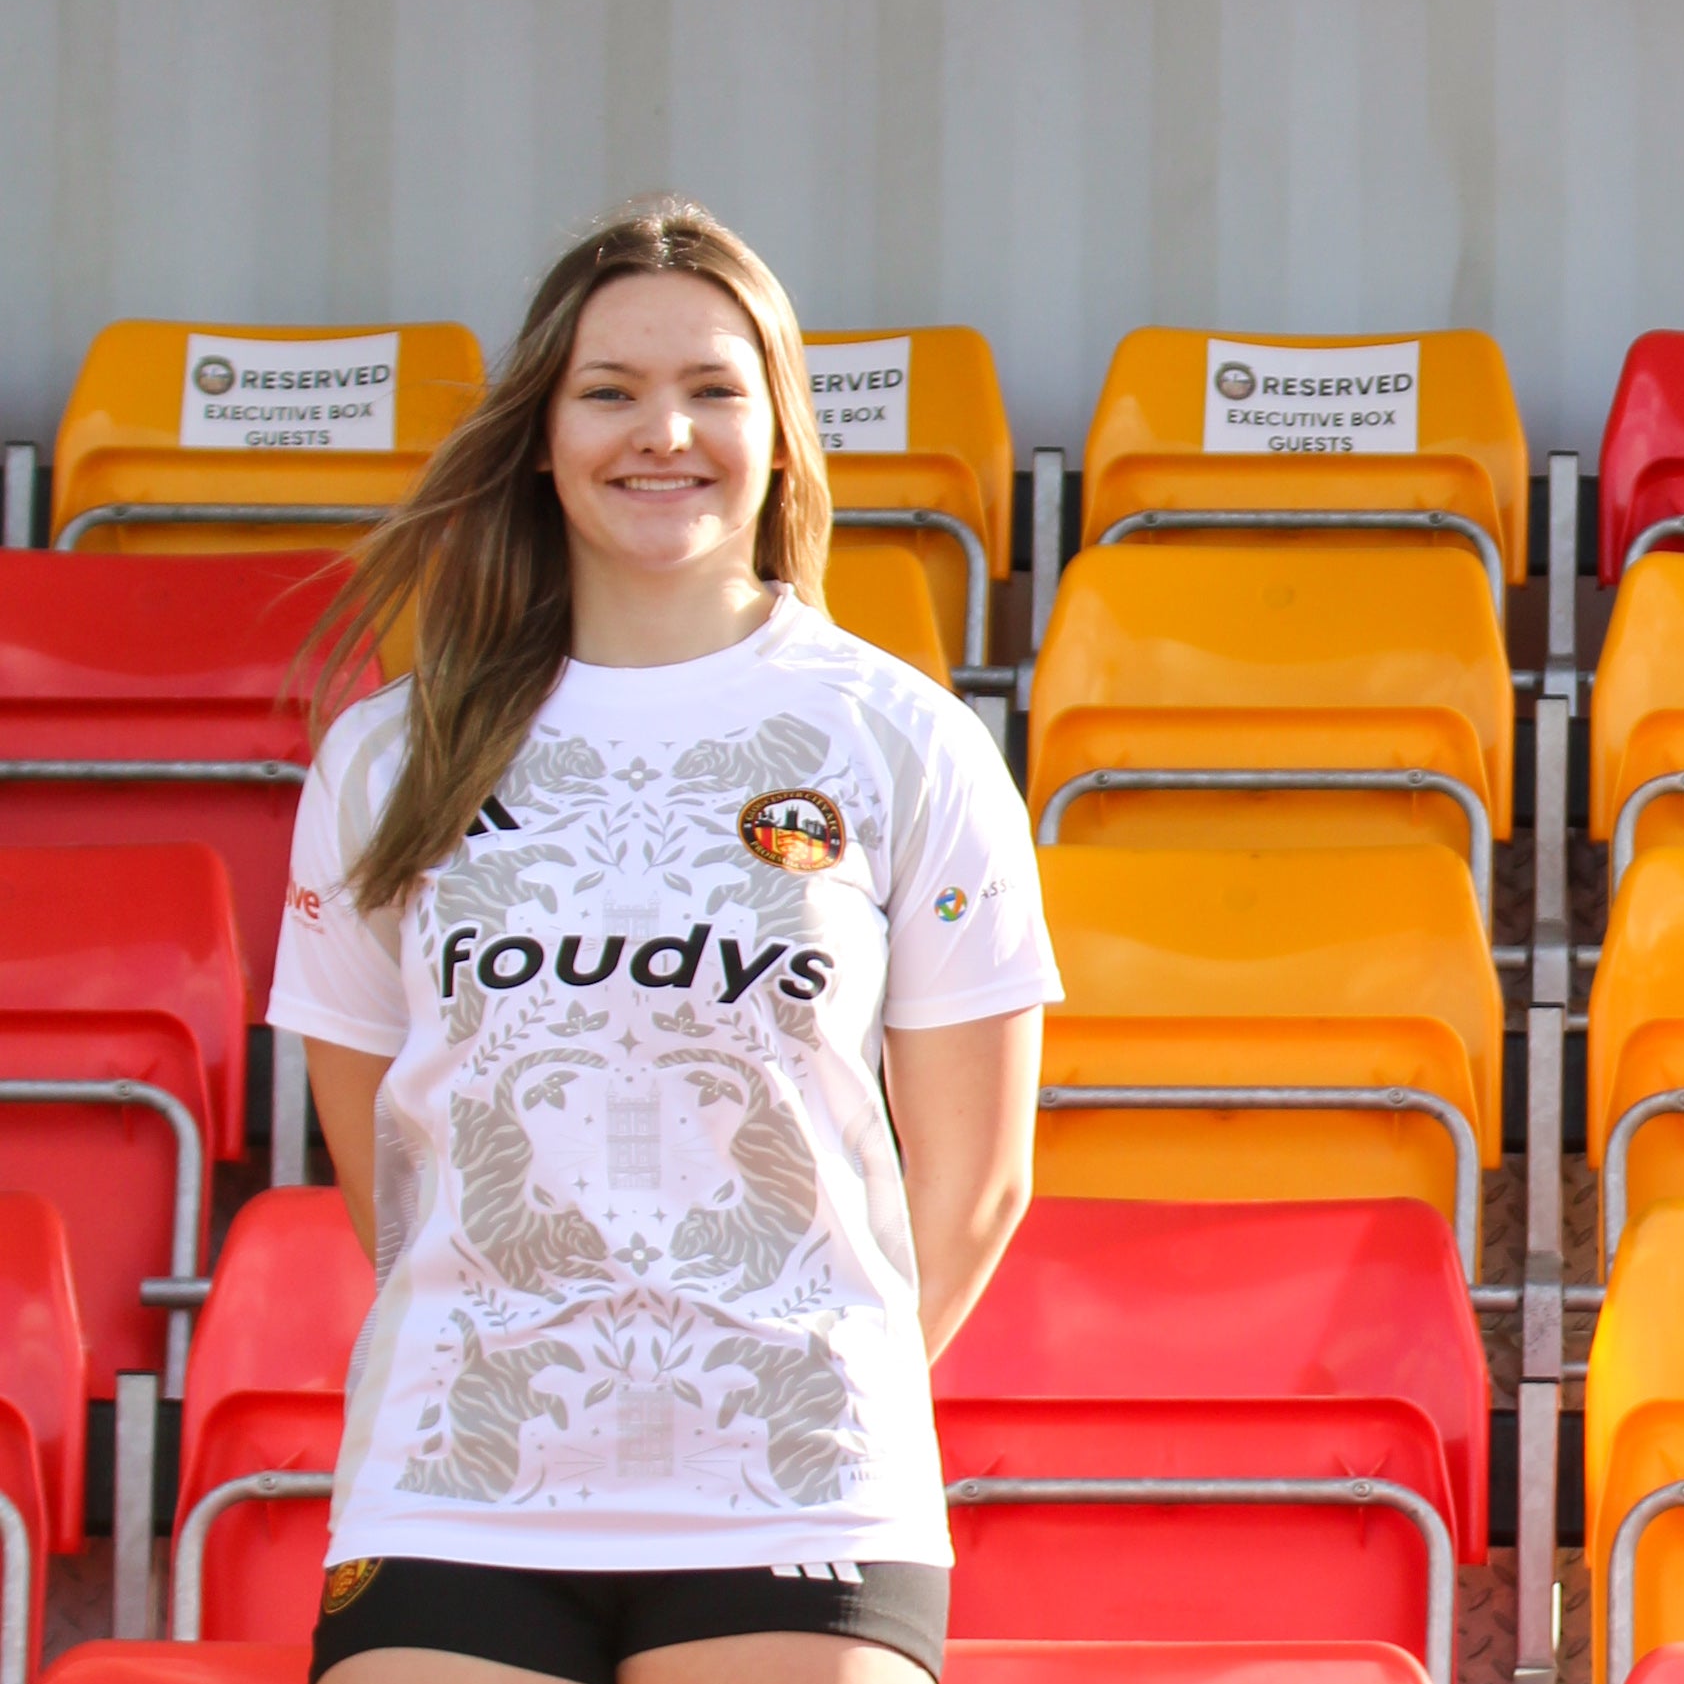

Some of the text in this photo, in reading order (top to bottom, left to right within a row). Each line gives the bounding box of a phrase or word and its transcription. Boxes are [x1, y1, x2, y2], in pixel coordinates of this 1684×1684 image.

[240, 363, 391, 390] RESERVED
[811, 368, 904, 393] ERVED
[1262, 373, 1413, 397] RESERVED
[203, 401, 374, 421] EXECUTIVE BOX
[841, 405, 886, 423] BOX
[1226, 408, 1396, 427] EXECUTIVE BOX
[245, 429, 331, 446] GUESTS
[1268, 435, 1354, 452] GUESTS
[443, 924, 835, 1004] foudys
